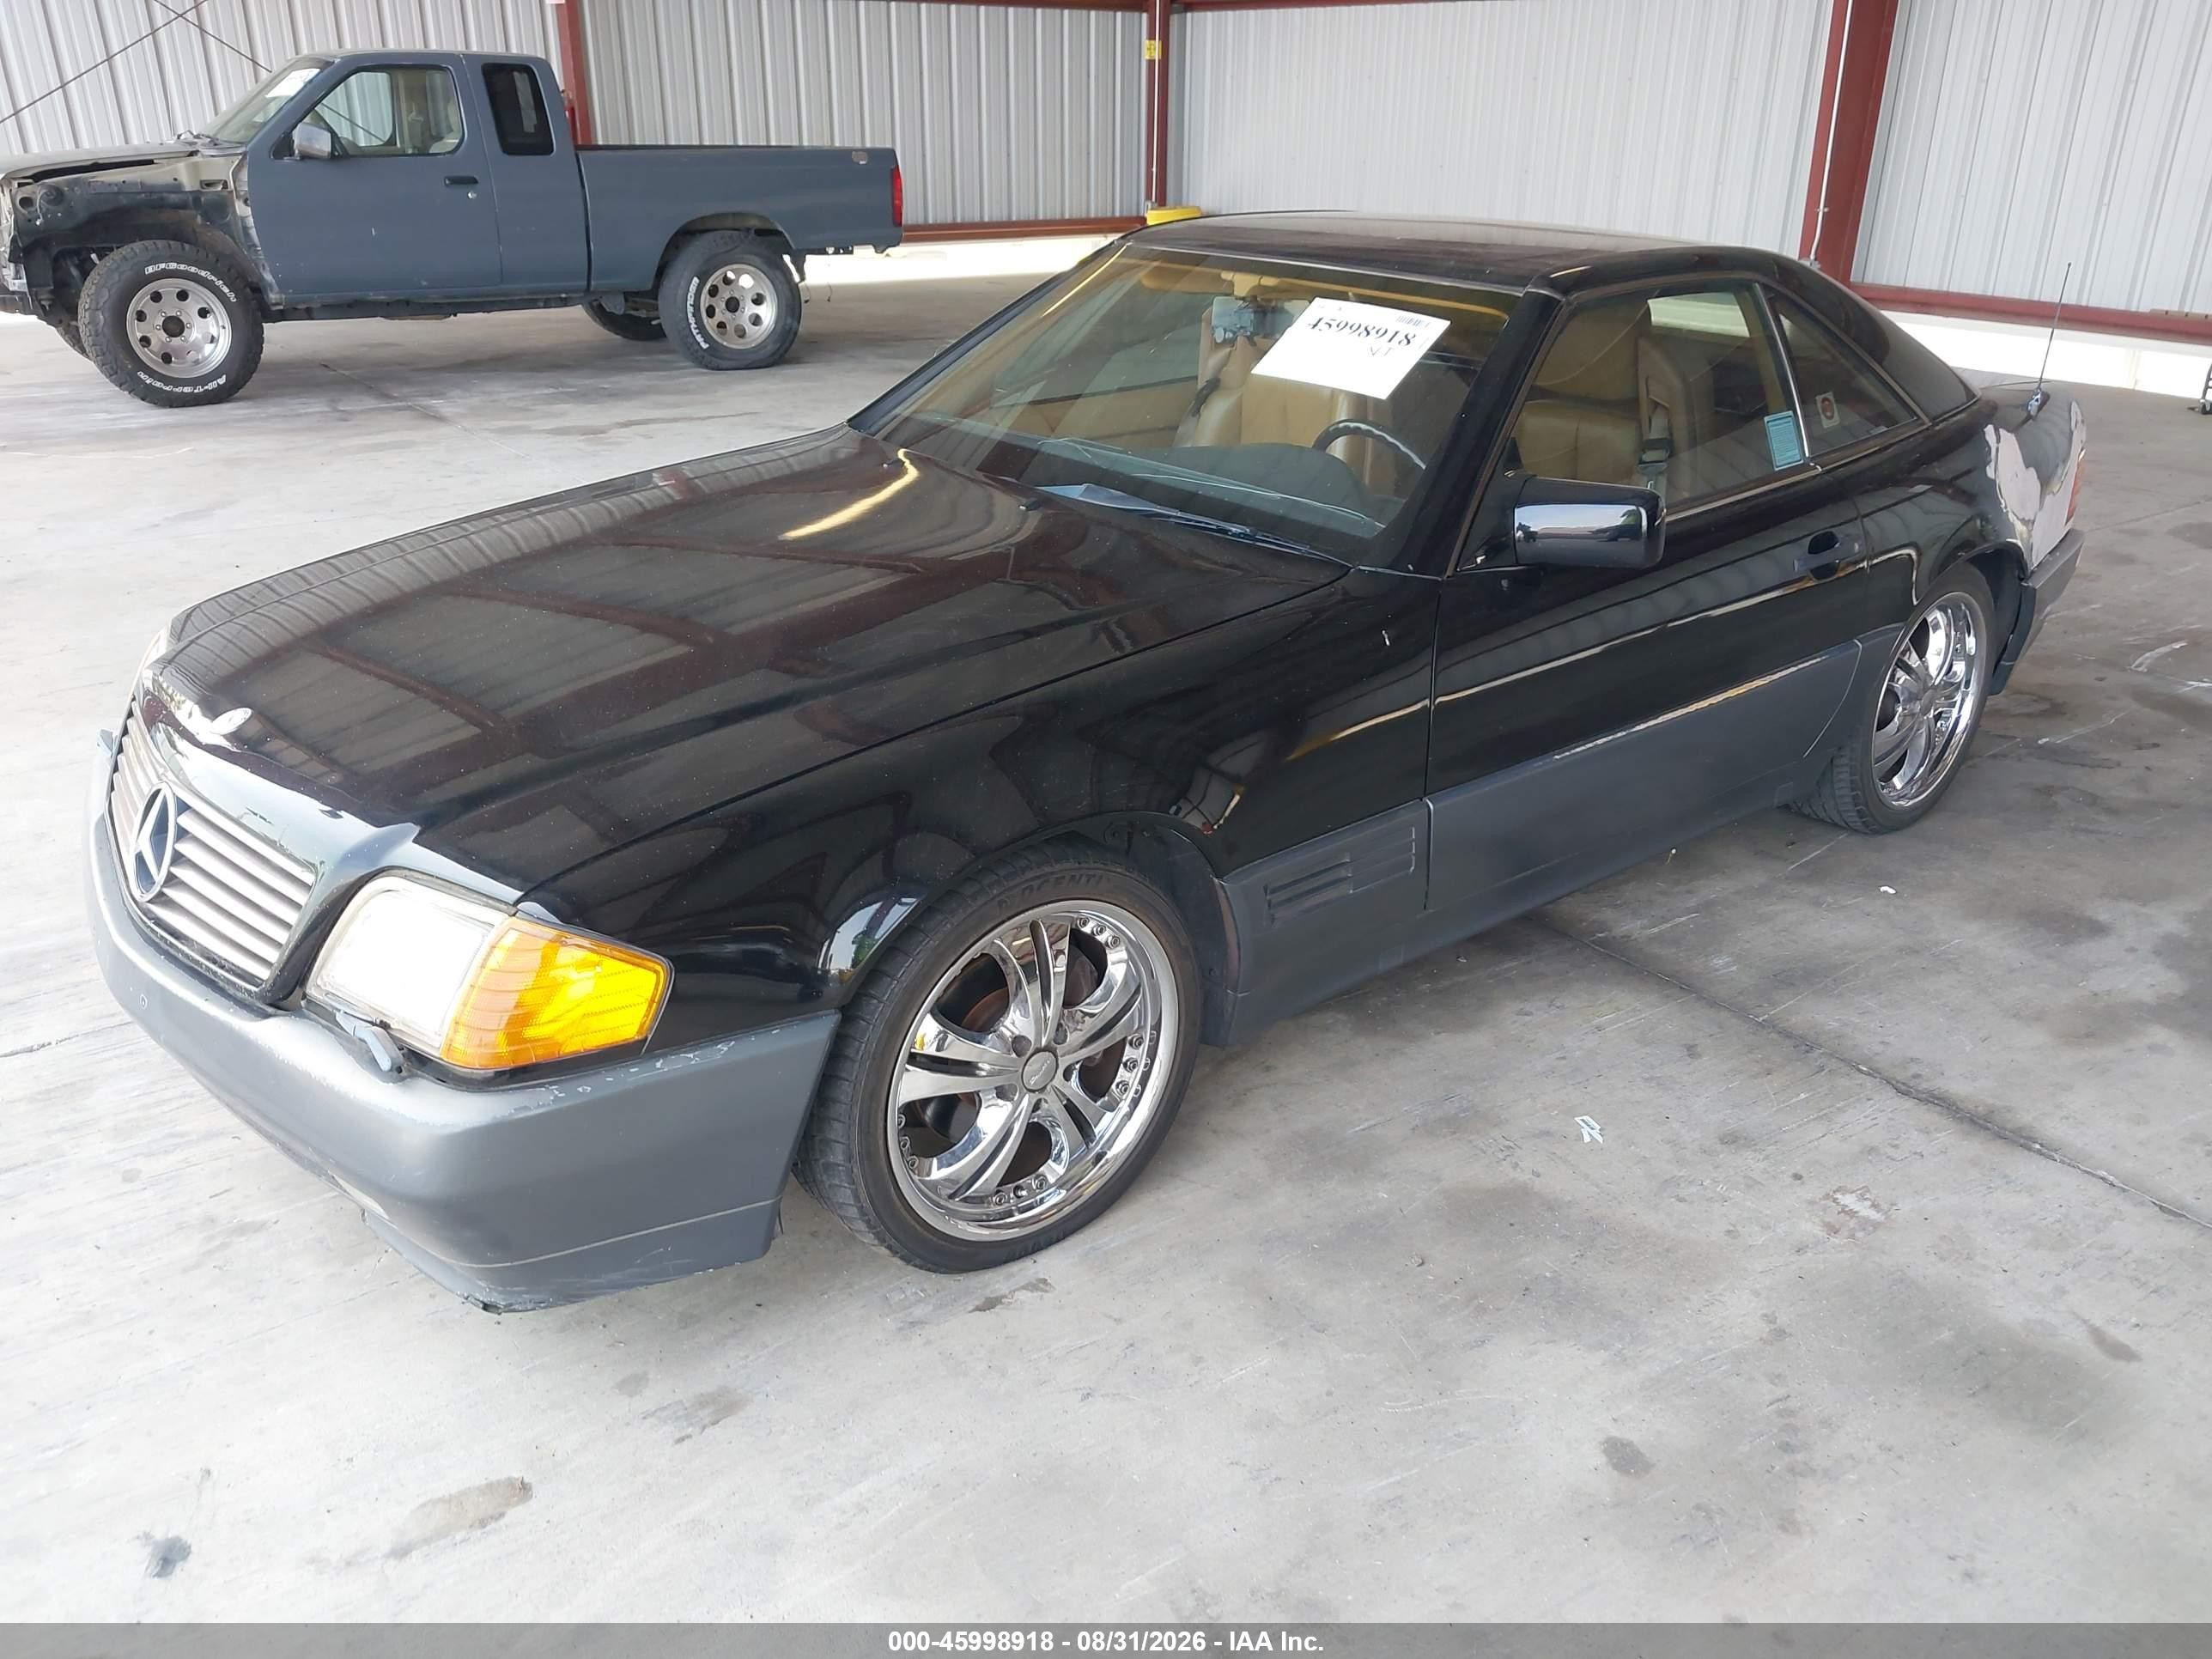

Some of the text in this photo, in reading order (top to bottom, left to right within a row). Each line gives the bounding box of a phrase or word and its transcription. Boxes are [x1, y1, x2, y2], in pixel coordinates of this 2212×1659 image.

[145, 262, 236, 301] BFGoodrich
[1308, 316, 1415, 346] 45998918
[137, 371, 226, 392] All-Terrain
